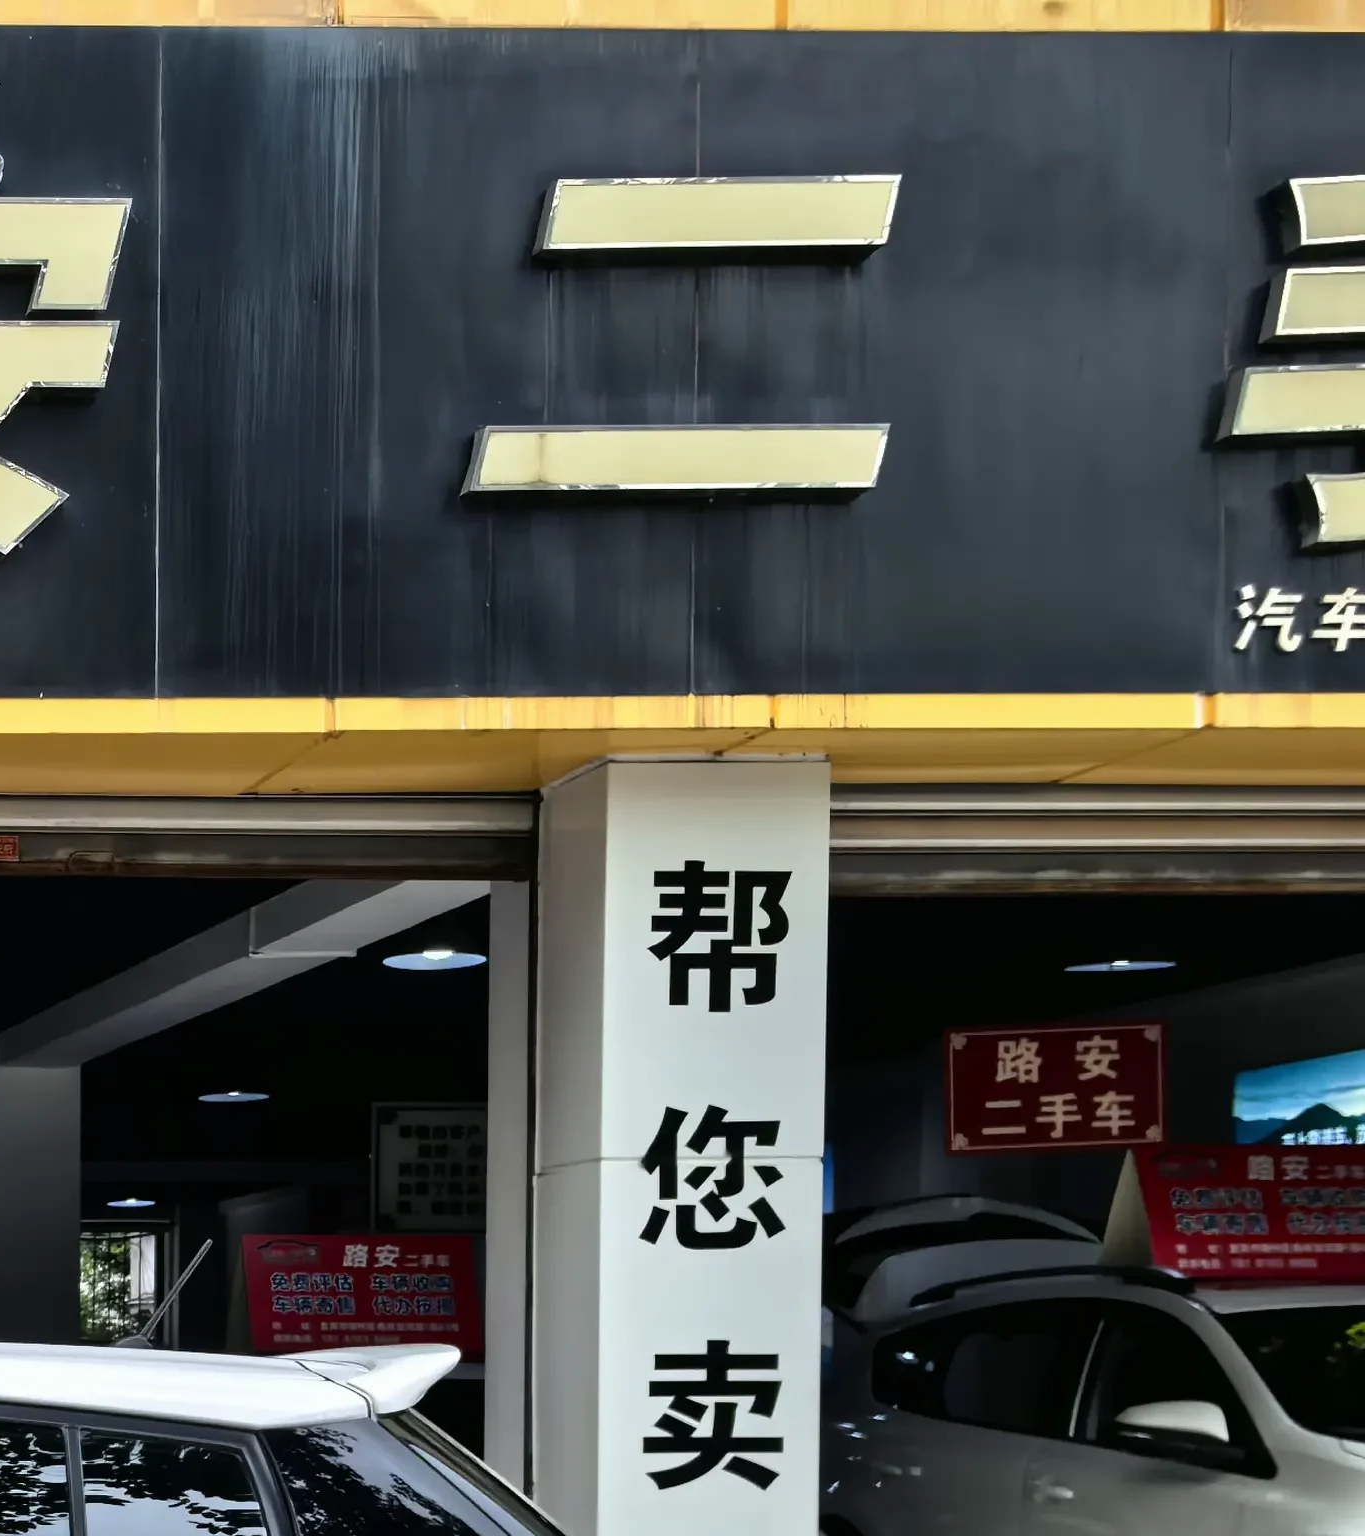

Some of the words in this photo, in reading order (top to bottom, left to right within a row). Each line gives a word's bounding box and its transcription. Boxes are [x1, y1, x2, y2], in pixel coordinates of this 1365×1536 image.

[996, 1035, 1121, 1084] 路安
[981, 1090, 1136, 1139] 二手车
[343, 1244, 400, 1268] 路安
